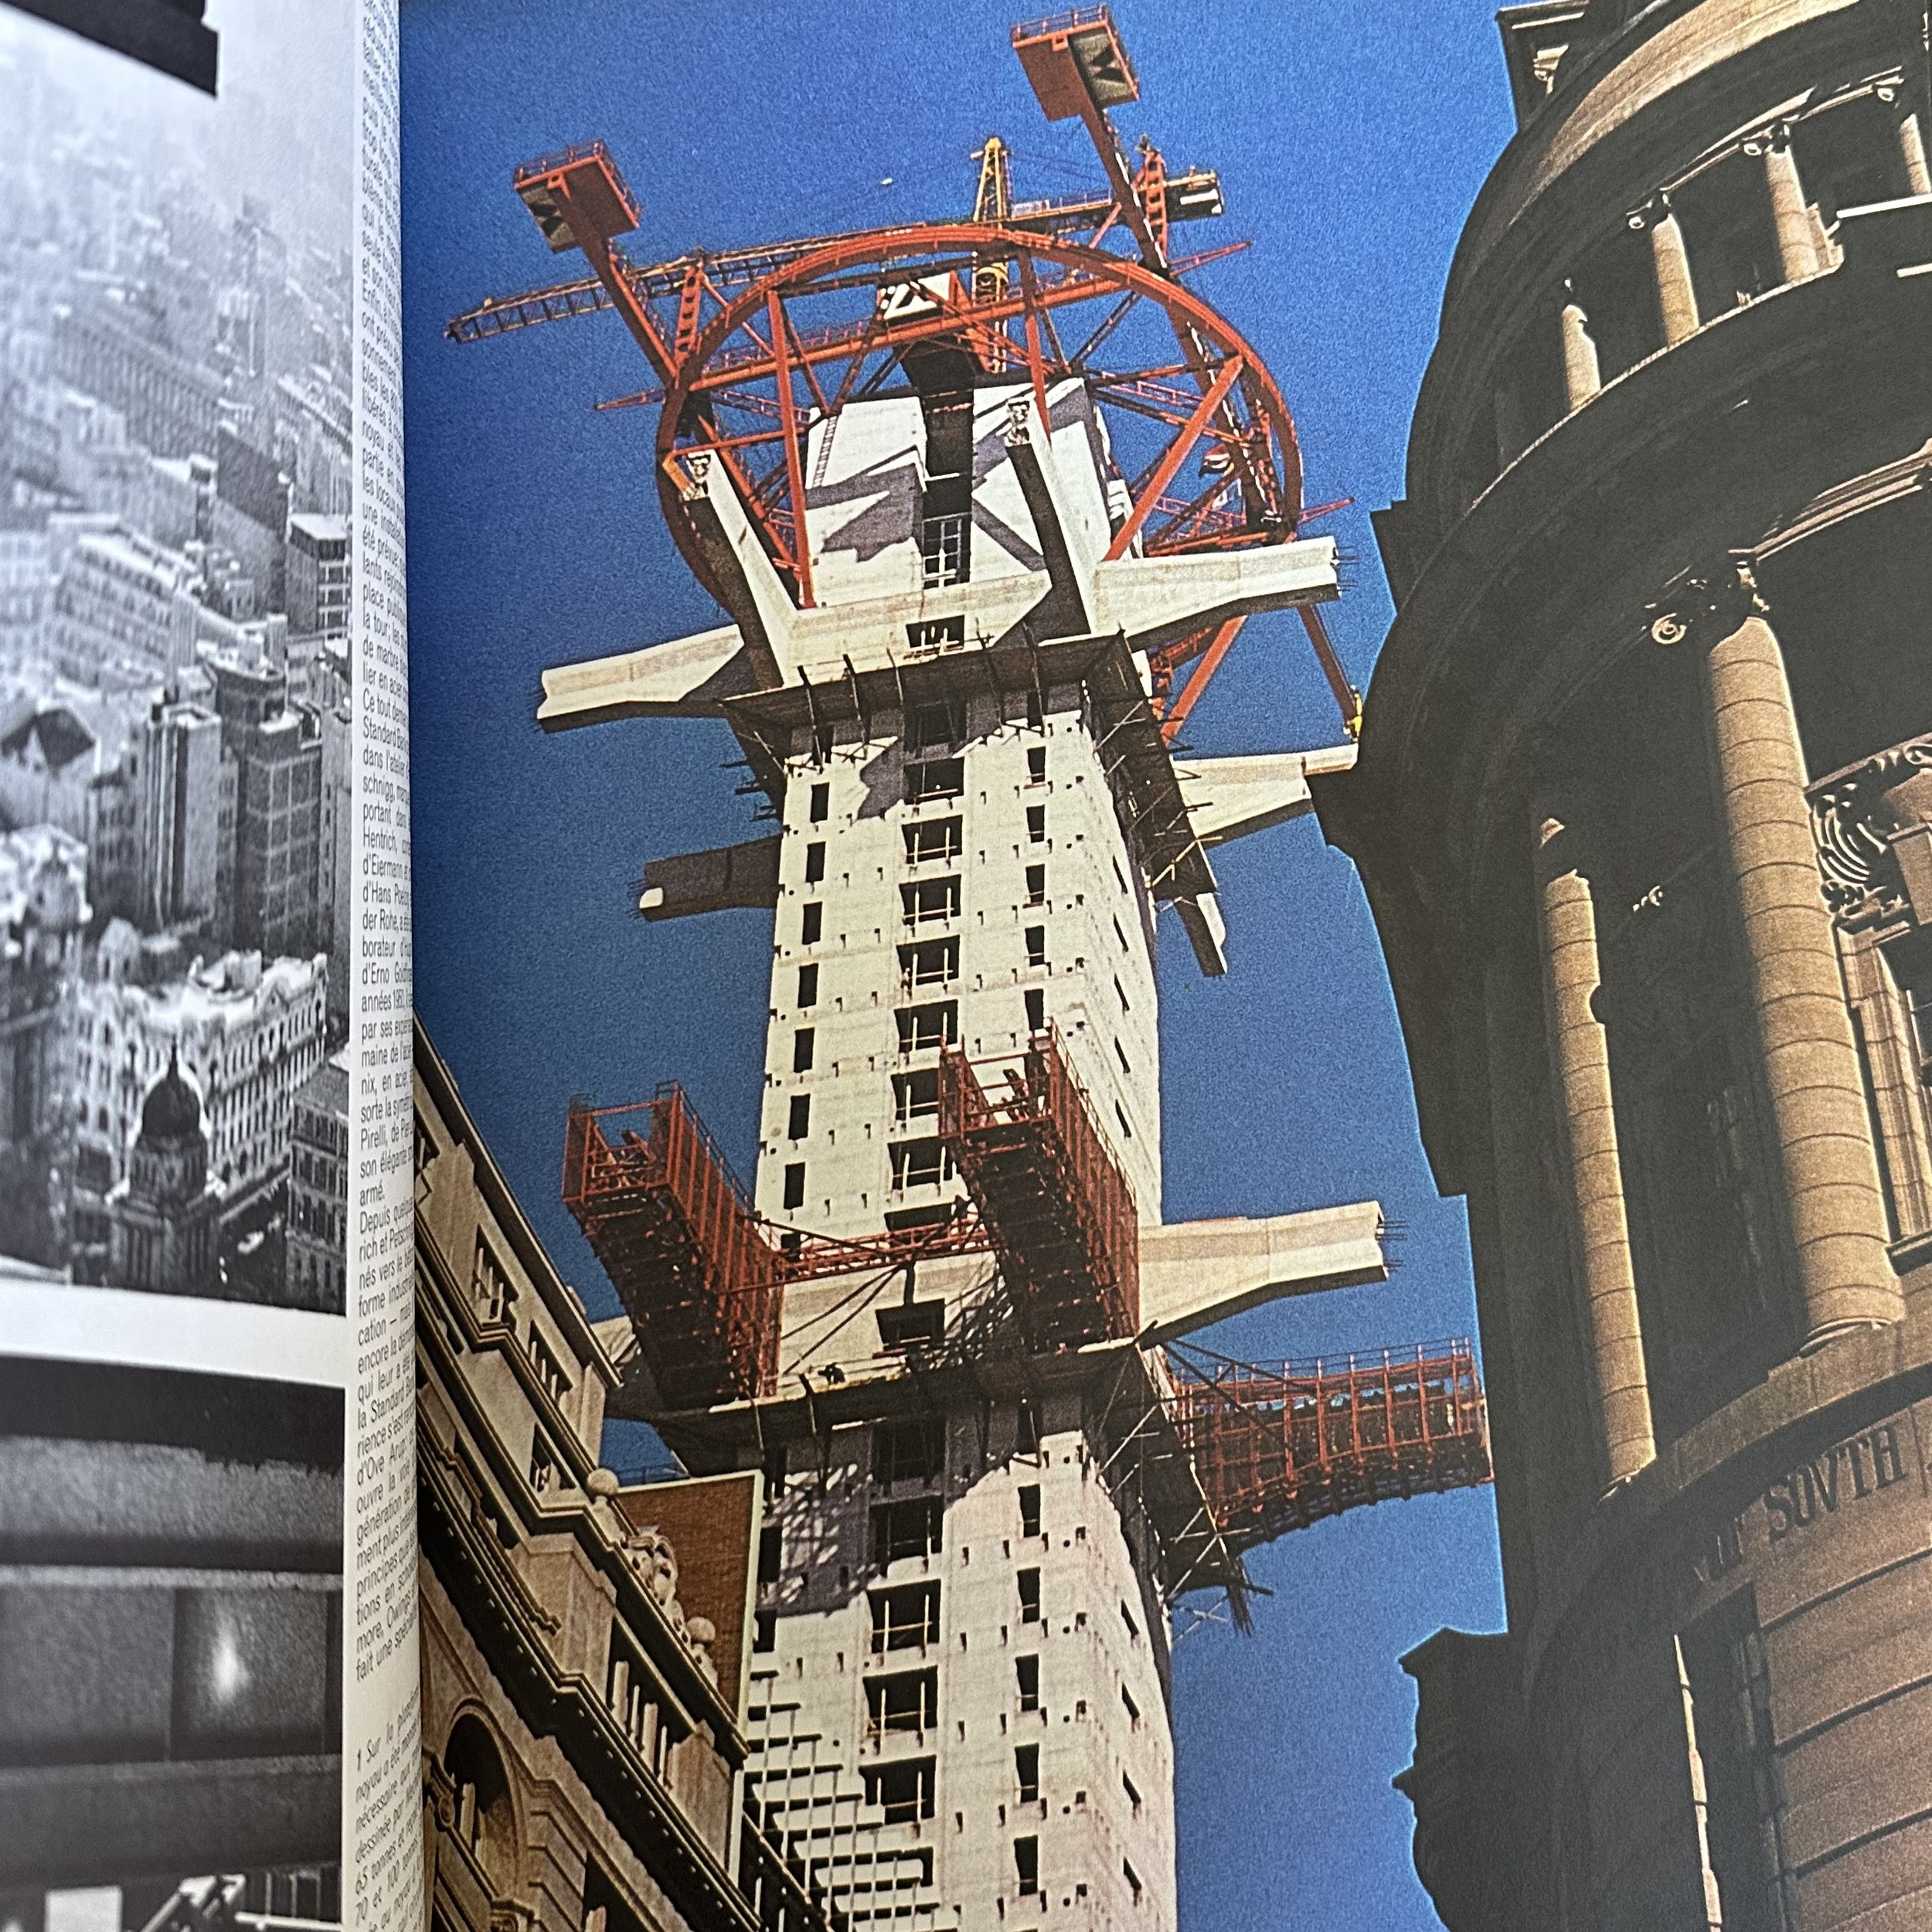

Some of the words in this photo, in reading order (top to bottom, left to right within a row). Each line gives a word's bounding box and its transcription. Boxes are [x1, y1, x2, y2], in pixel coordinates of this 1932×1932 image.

[363, 582, 384, 609] place
[363, 635, 373, 658] de
[363, 662, 376, 685] lier
[379, 672, 388, 690] en
[362, 688, 375, 713] Ce
[377, 694, 391, 718] tout
[363, 716, 396, 746] Standard
[363, 745, 383, 769] dans
[363, 801, 391, 825] portant
[363, 825, 397, 852] Hentrich,
[363, 881, 391, 903] d'Hans
[362, 909, 377, 930] der
[362, 937, 395, 957] borateur
[362, 962, 389, 985] d'Erno
[362, 991, 392, 1012] années
[362, 1022, 377, 1045] par
[380, 1021, 393, 1038] ses
[362, 1044, 387, 1066] maine
[390, 1043, 398, 1063] de
[361, 1073, 377, 1096] nix,
[382, 1075, 392, 1092] en
[361, 1100, 383, 1123] sorte
[360, 1125, 387, 1150] Pirelli,
[360, 1160, 376, 1179] son
[359, 1181, 384, 1206] armé.
[360, 1206, 390, 1234] Depuis
[359, 1236, 378, 1262] rich
[379, 1233, 388, 1254] et
[359, 1266, 376, 1290] nés
[379, 1260, 395, 1281] vers
[359, 1293, 385, 1317] forme
[358, 1319, 386, 1346] cation
[358, 1345, 389, 1374] encore
[358, 1376, 373, 1410] qui
[378, 1368, 393, 1391] leur
[357, 1404, 367, 1430] la
[371, 1384, 404, 1423] Standard
[357, 1428, 386, 1458] rience
[1764, 1424, 1909, 1543] SOVTH
[357, 1485, 383, 1514] ouvre
[357, 1536, 382, 1569] ment
[357, 1595, 380, 1625] tions
[385, 1583, 395, 1604] en
[357, 1622, 383, 1659] more,
[356, 1651, 373, 1681] fait
[376, 1639, 393, 1665] une
